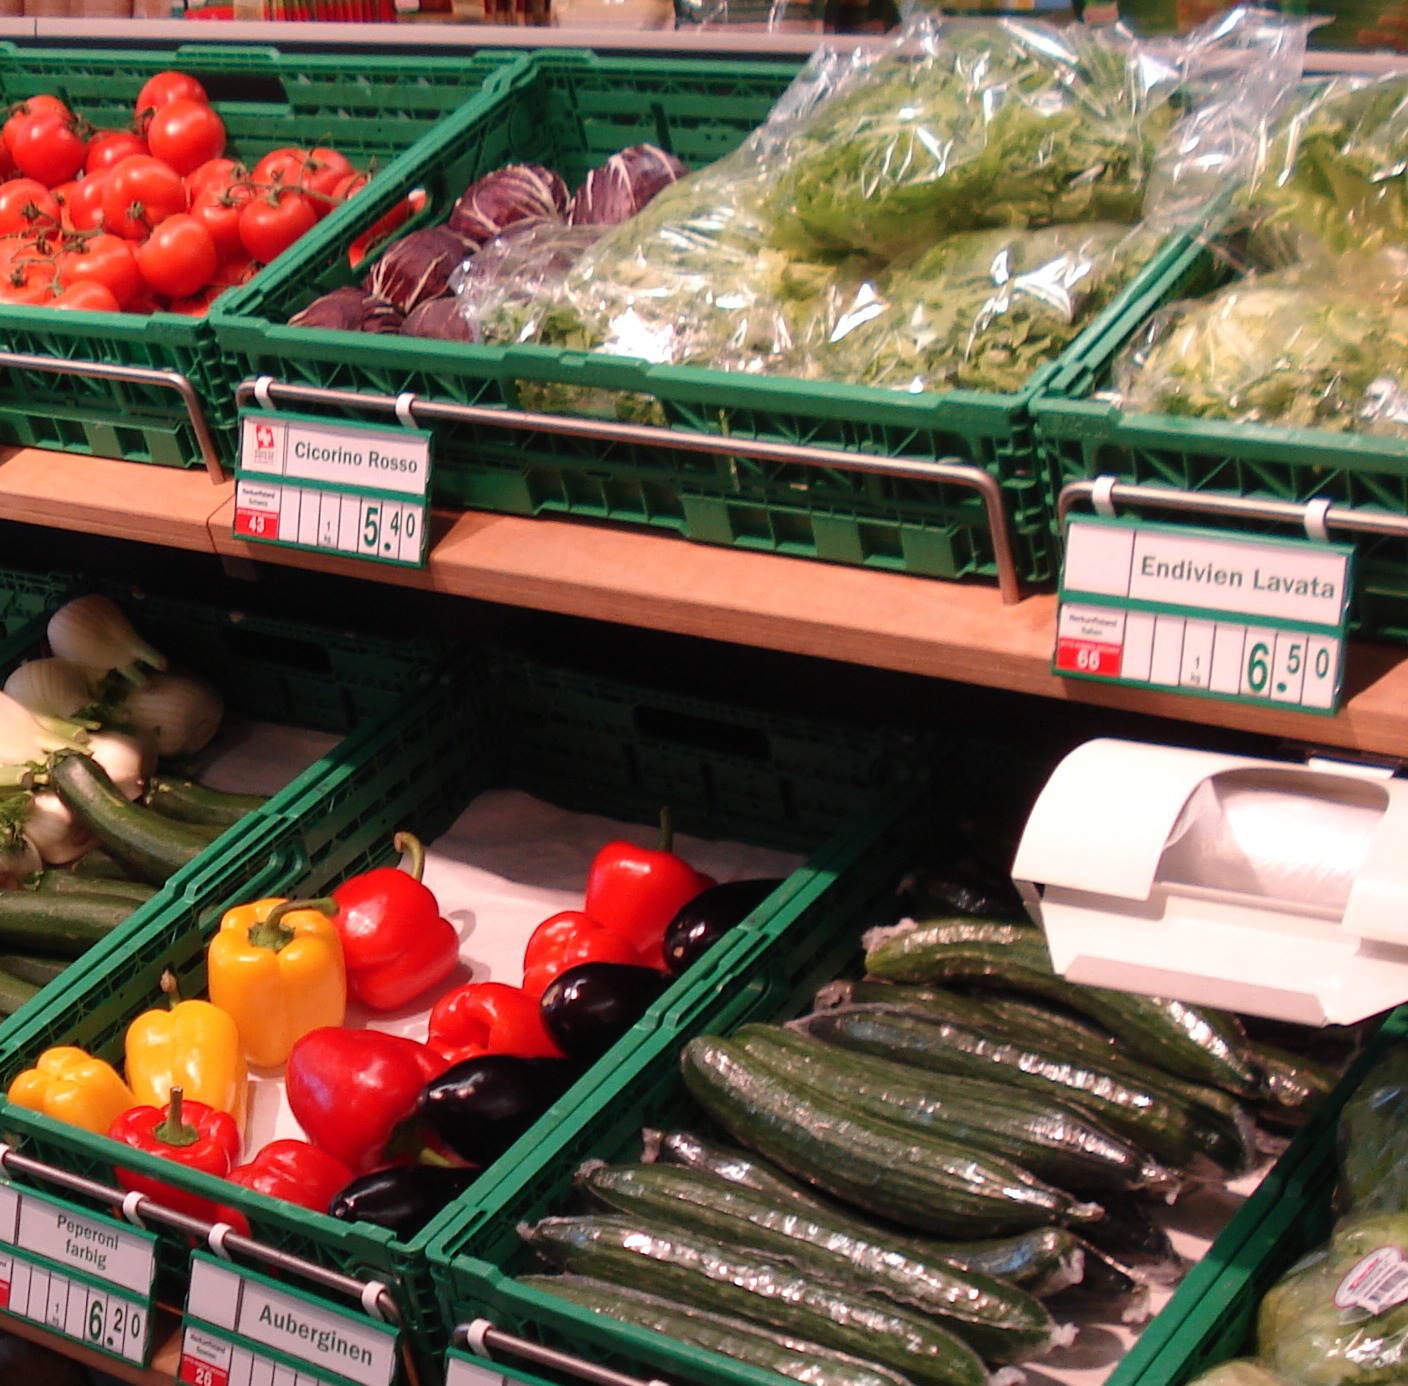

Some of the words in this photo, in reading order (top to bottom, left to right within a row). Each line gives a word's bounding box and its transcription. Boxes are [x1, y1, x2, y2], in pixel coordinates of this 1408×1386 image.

[295, 441, 362, 466] Cicorino
[369, 451, 418, 473] Rosso
[249, 517, 264, 533] 43
[363, 506, 415, 550] 5.40
[1141, 555, 1243, 587] Endivien
[1253, 569, 1335, 599] Lavata
[1077, 650, 1100, 671] 66
[1247, 643, 1329, 692] 6.50
[57, 1214, 119, 1250] Peperoni
[65, 1239, 107, 1271] farbig
[89, 1300, 141, 1347] 6.20
[259, 1305, 373, 1366] Auberginen
[195, 1368, 213, 1386] 26
